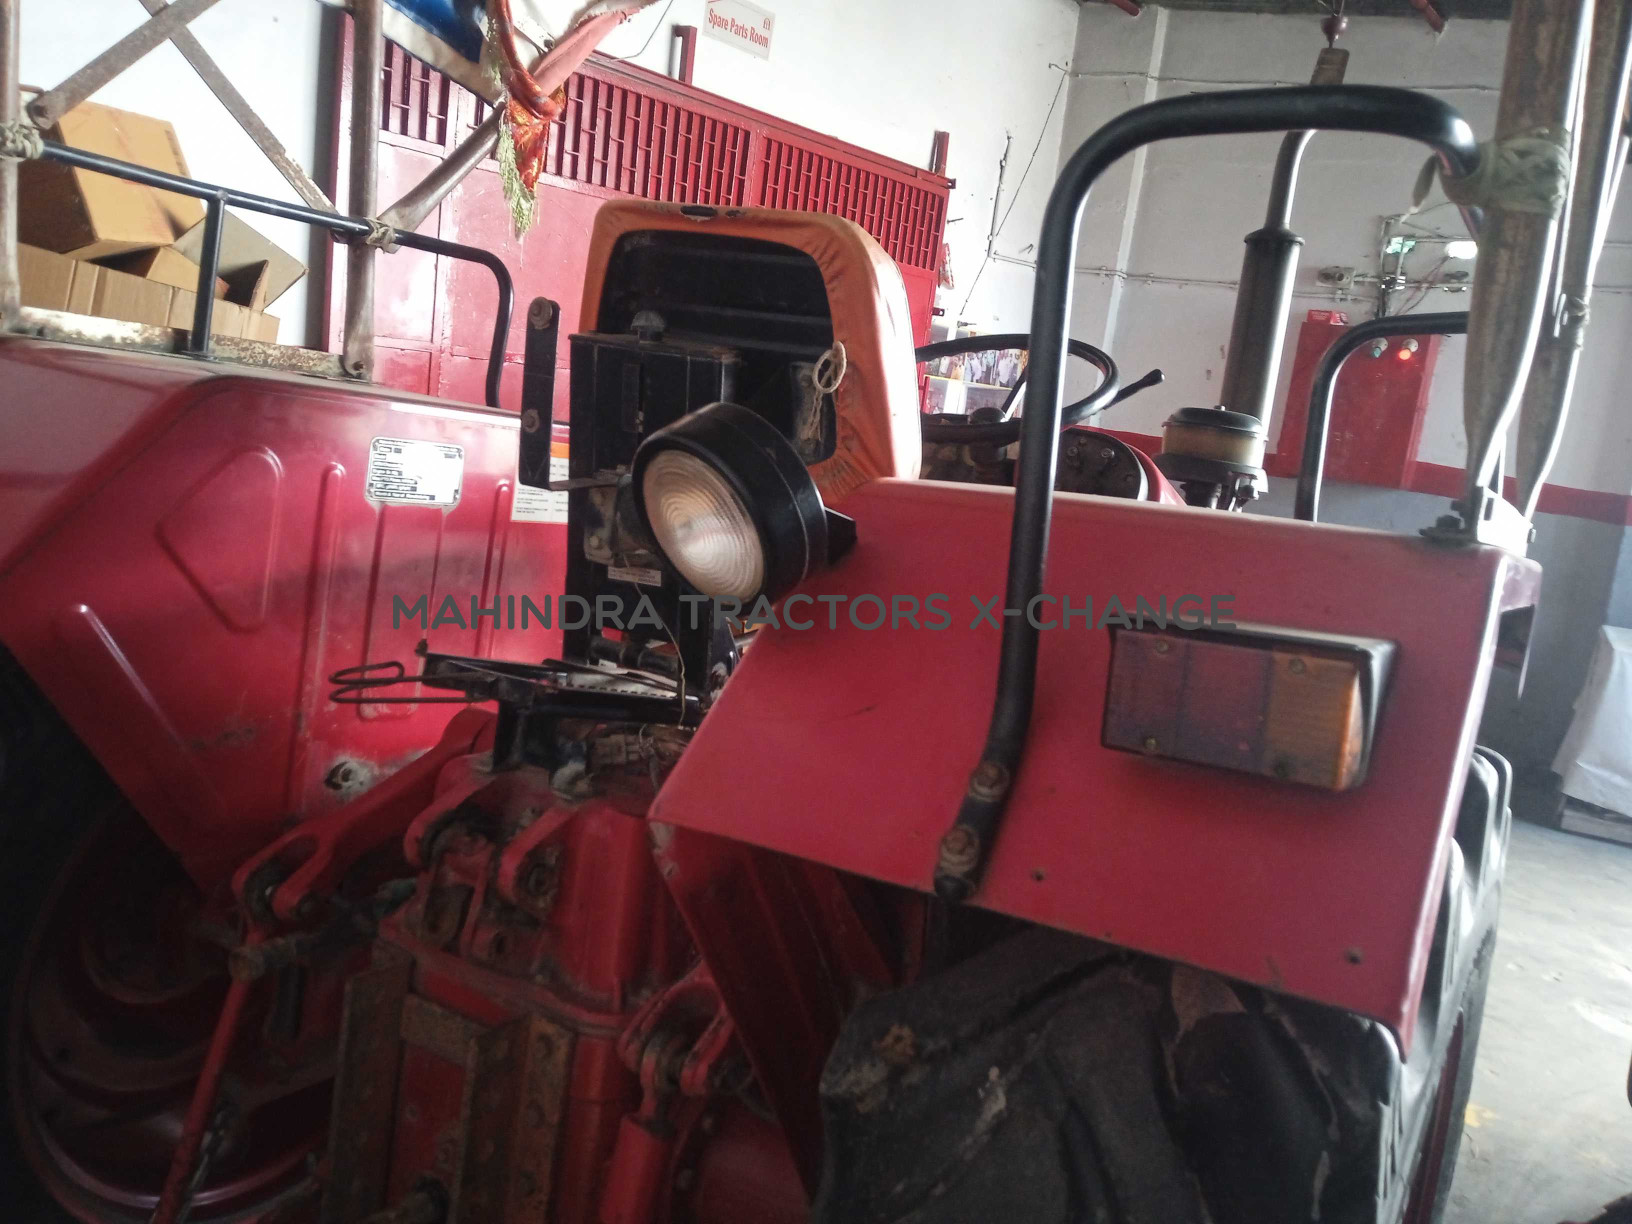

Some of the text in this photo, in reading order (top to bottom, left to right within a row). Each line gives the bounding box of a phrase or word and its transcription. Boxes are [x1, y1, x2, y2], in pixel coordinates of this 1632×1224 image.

[708, 7, 769, 48] Spare Parts Room
